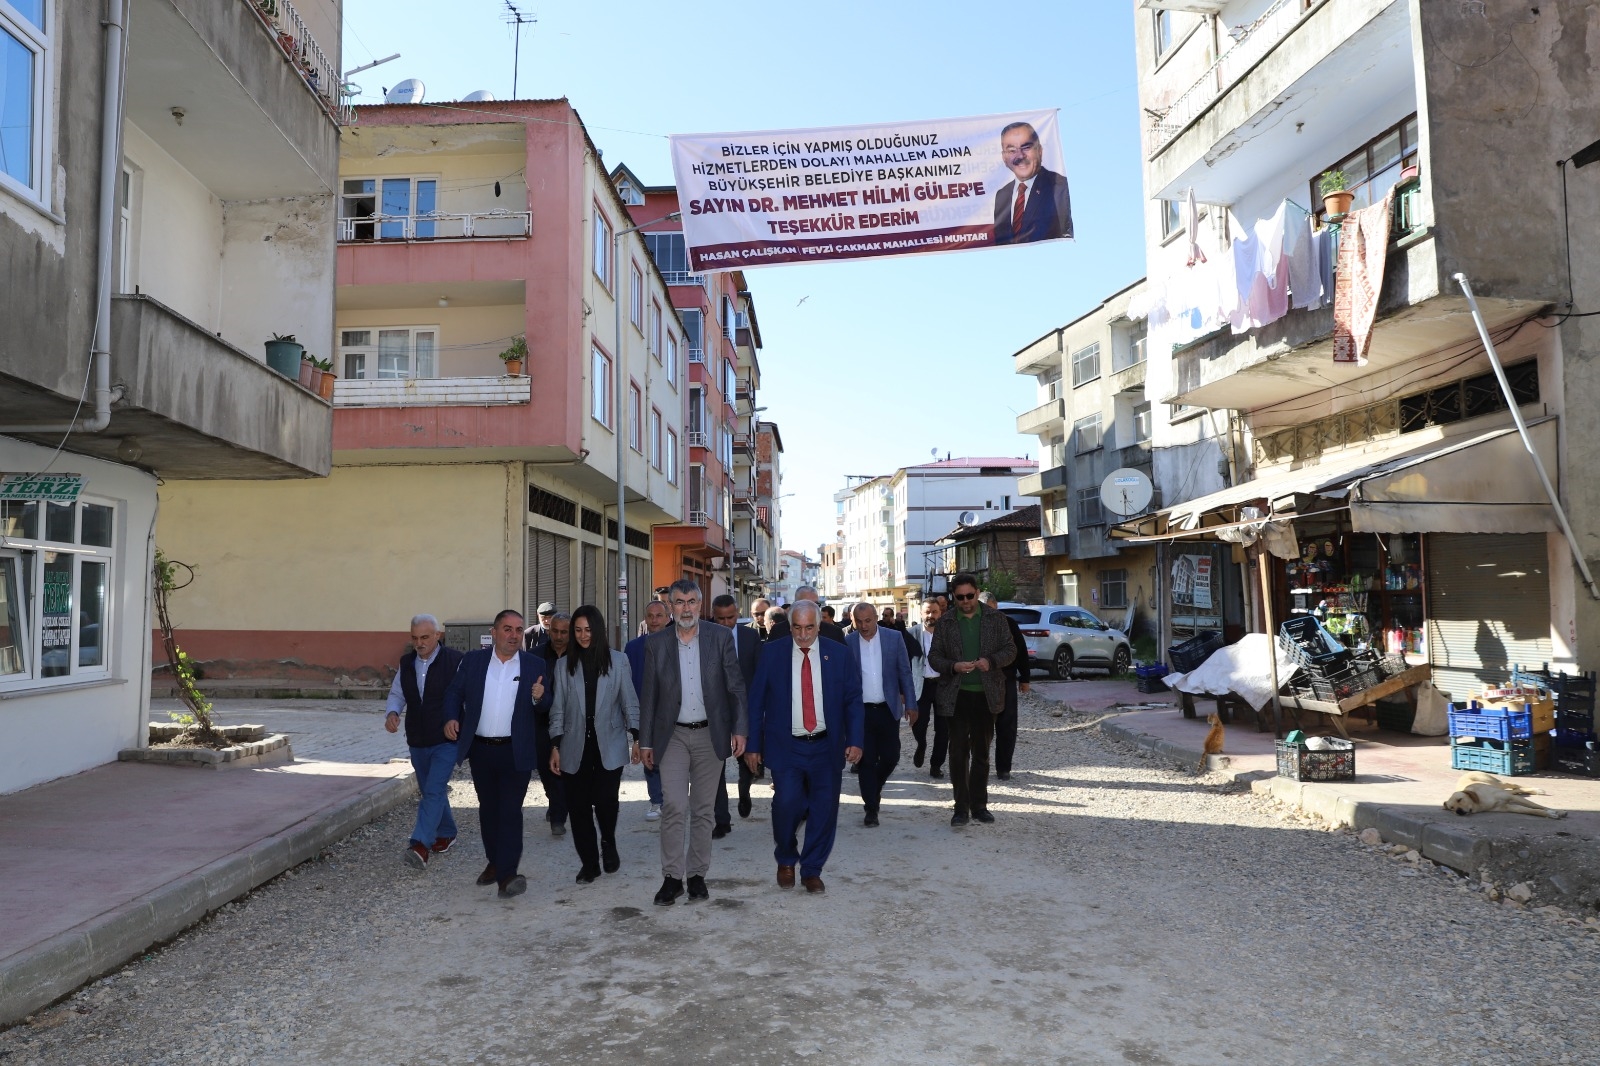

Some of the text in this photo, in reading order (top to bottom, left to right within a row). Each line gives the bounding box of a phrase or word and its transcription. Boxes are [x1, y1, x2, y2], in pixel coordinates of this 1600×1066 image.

[722, 134, 938, 156] BİZLER İÇİN YAPMIŞ OLDUĞUNUZ
[693, 146, 971, 175] HİZMETLERDEN DOLAYI MAHALLEM ADINA
[709, 174, 800, 191] BÜYÜKŞEHİR
[806, 169, 873, 186] BELEDİYE
[878, 164, 961, 180] BAŞKANIMIZ
[690, 197, 744, 215] SAYIN
[748, 197, 779, 212] DR.
[783, 191, 858, 211] MEHMET
[863, 183, 910, 204] HİLMİ
[767, 213, 855, 235] TEŞEKKÜR
[859, 211, 919, 229] EDERİM
[700, 233, 988, 261] HASAN ÇALIŞKAN FEVZİ ÇAKMAK MAHALLESİ MUHTARI
